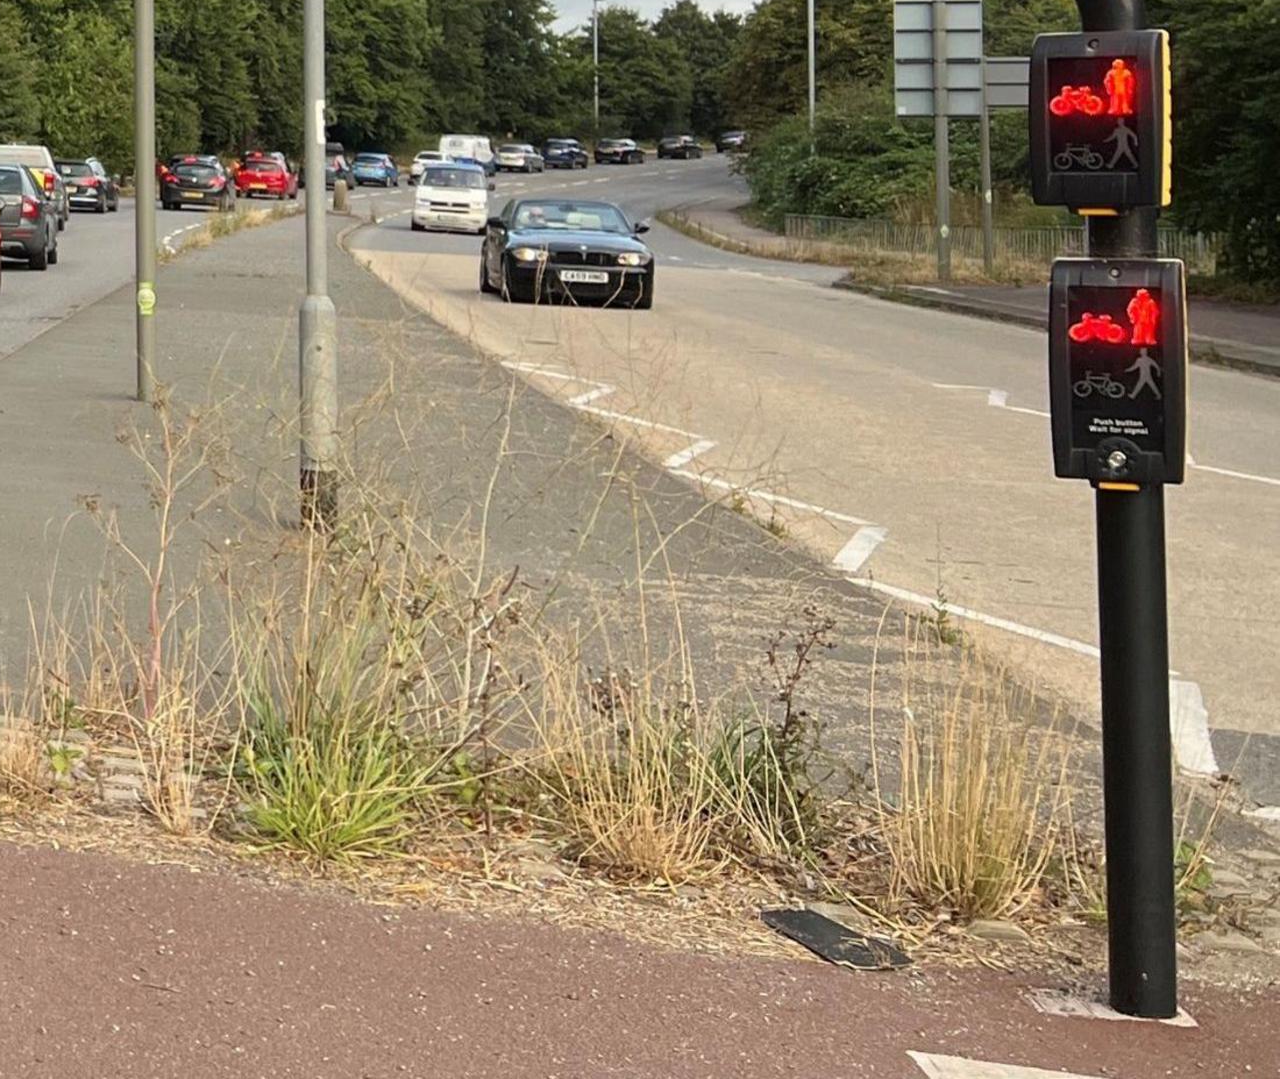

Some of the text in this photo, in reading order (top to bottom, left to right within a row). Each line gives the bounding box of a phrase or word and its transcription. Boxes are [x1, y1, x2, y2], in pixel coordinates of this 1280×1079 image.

[1093, 418, 1144, 427] Push button
[1123, 427, 1149, 436] signal
